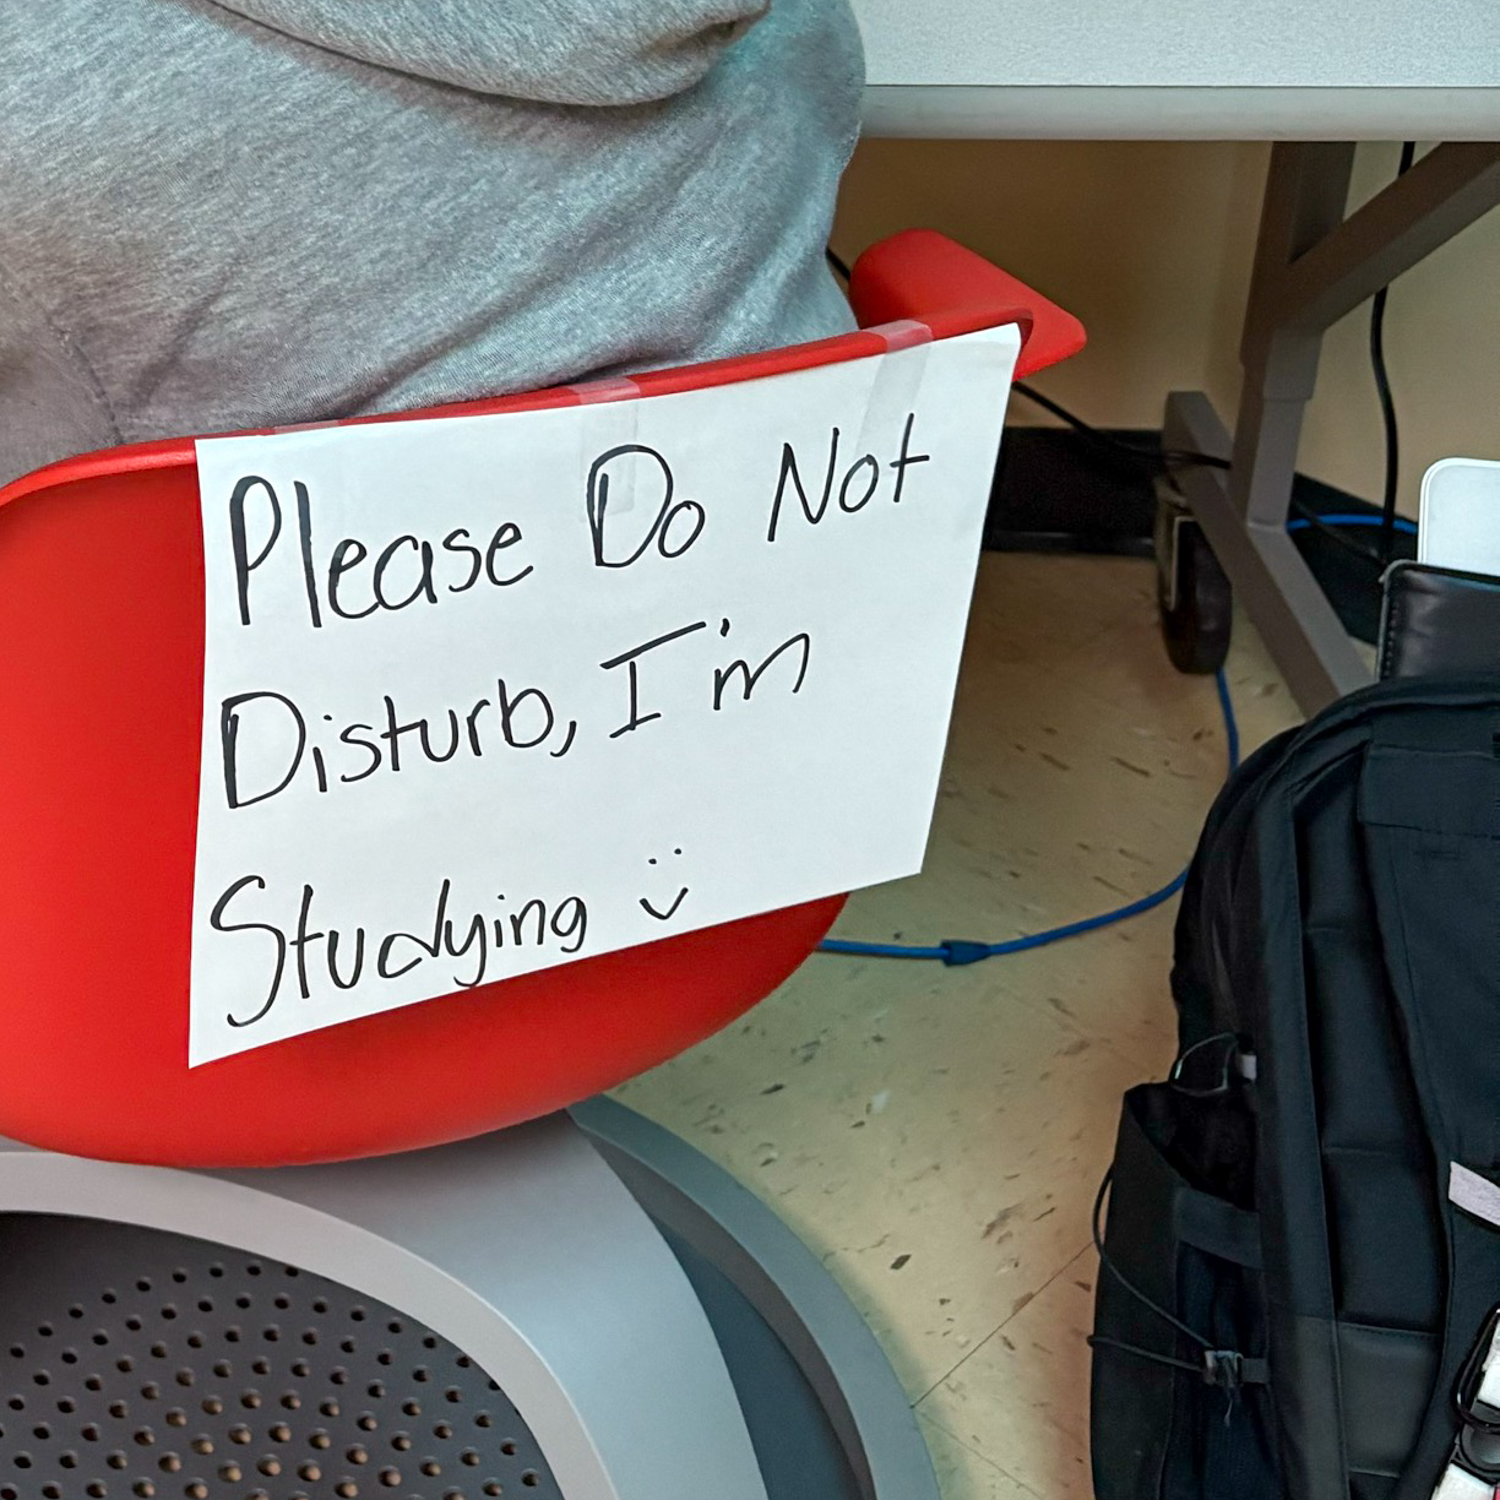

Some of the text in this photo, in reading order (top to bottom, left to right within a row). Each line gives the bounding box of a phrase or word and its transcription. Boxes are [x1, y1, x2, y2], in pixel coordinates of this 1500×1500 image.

[230, 413, 930, 627] Please Do Not
[222, 618, 810, 808] Disturb, I'm
[212, 875, 587, 1028] Studying
